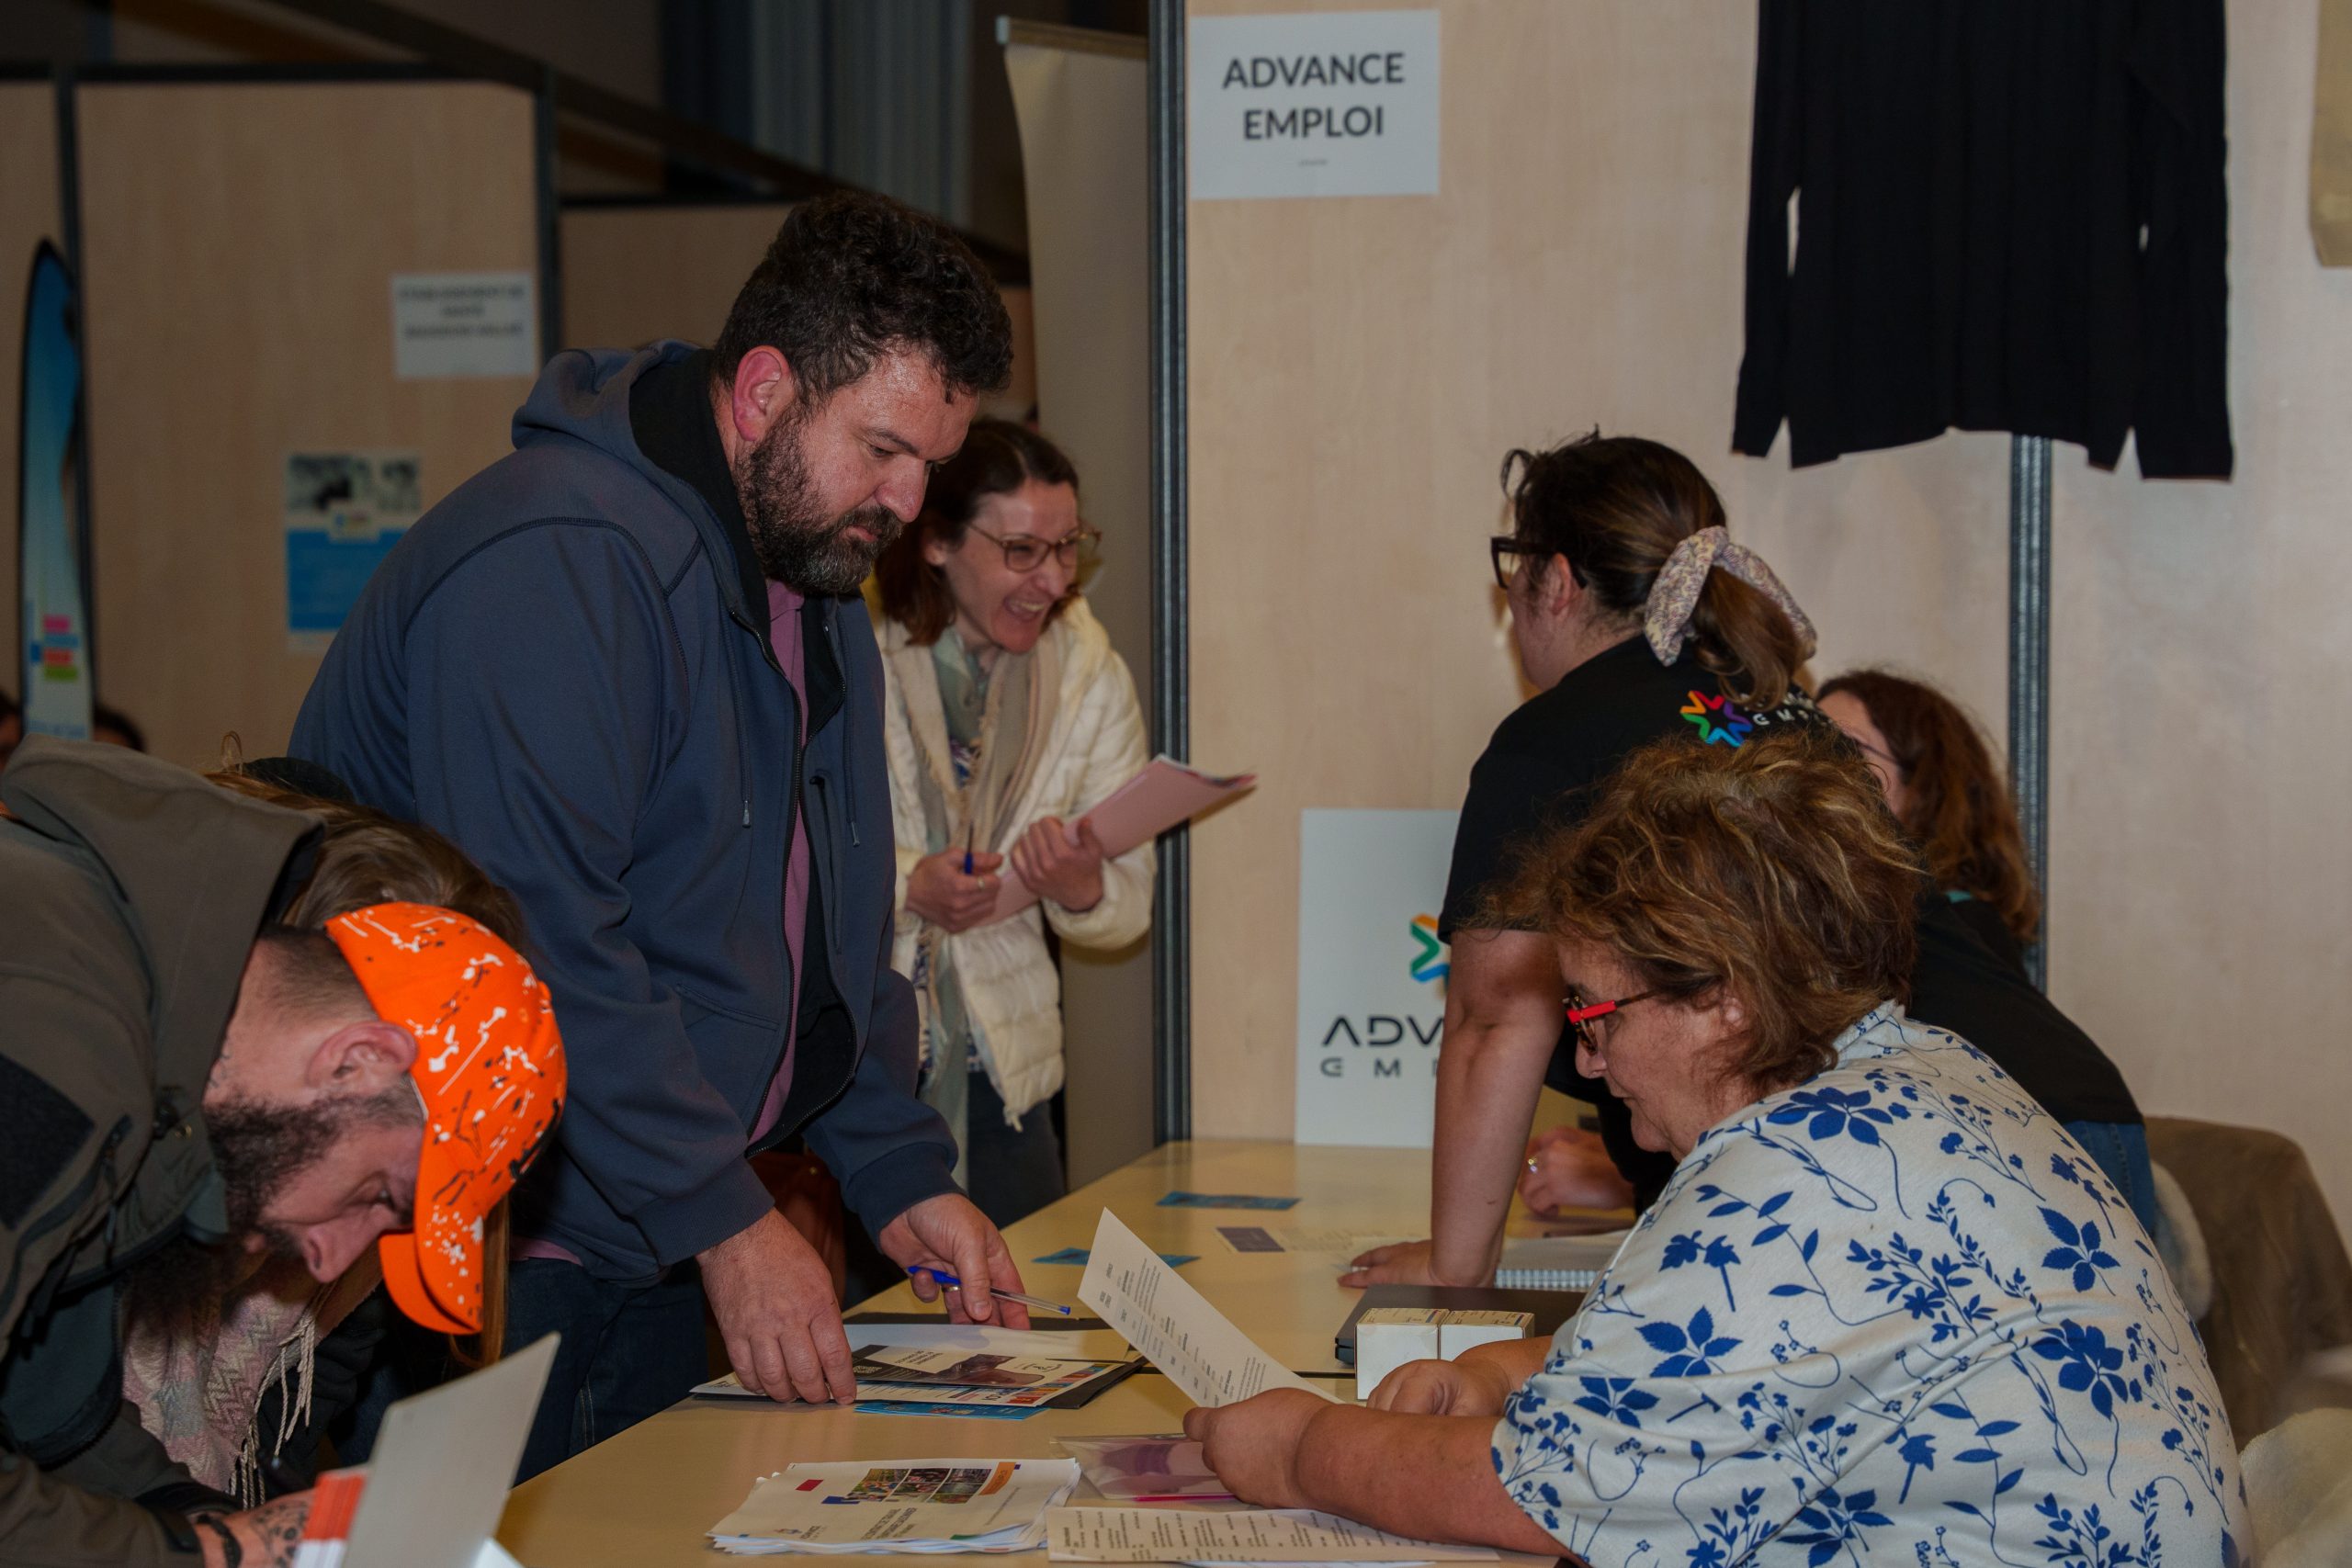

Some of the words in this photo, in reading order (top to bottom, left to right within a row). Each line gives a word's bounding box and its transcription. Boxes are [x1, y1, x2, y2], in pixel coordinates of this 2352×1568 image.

[1222, 51, 1405, 90] ADVANCE
[1244, 106, 1384, 141] EMPLOI
[1322, 1015, 1444, 1047] ADV
